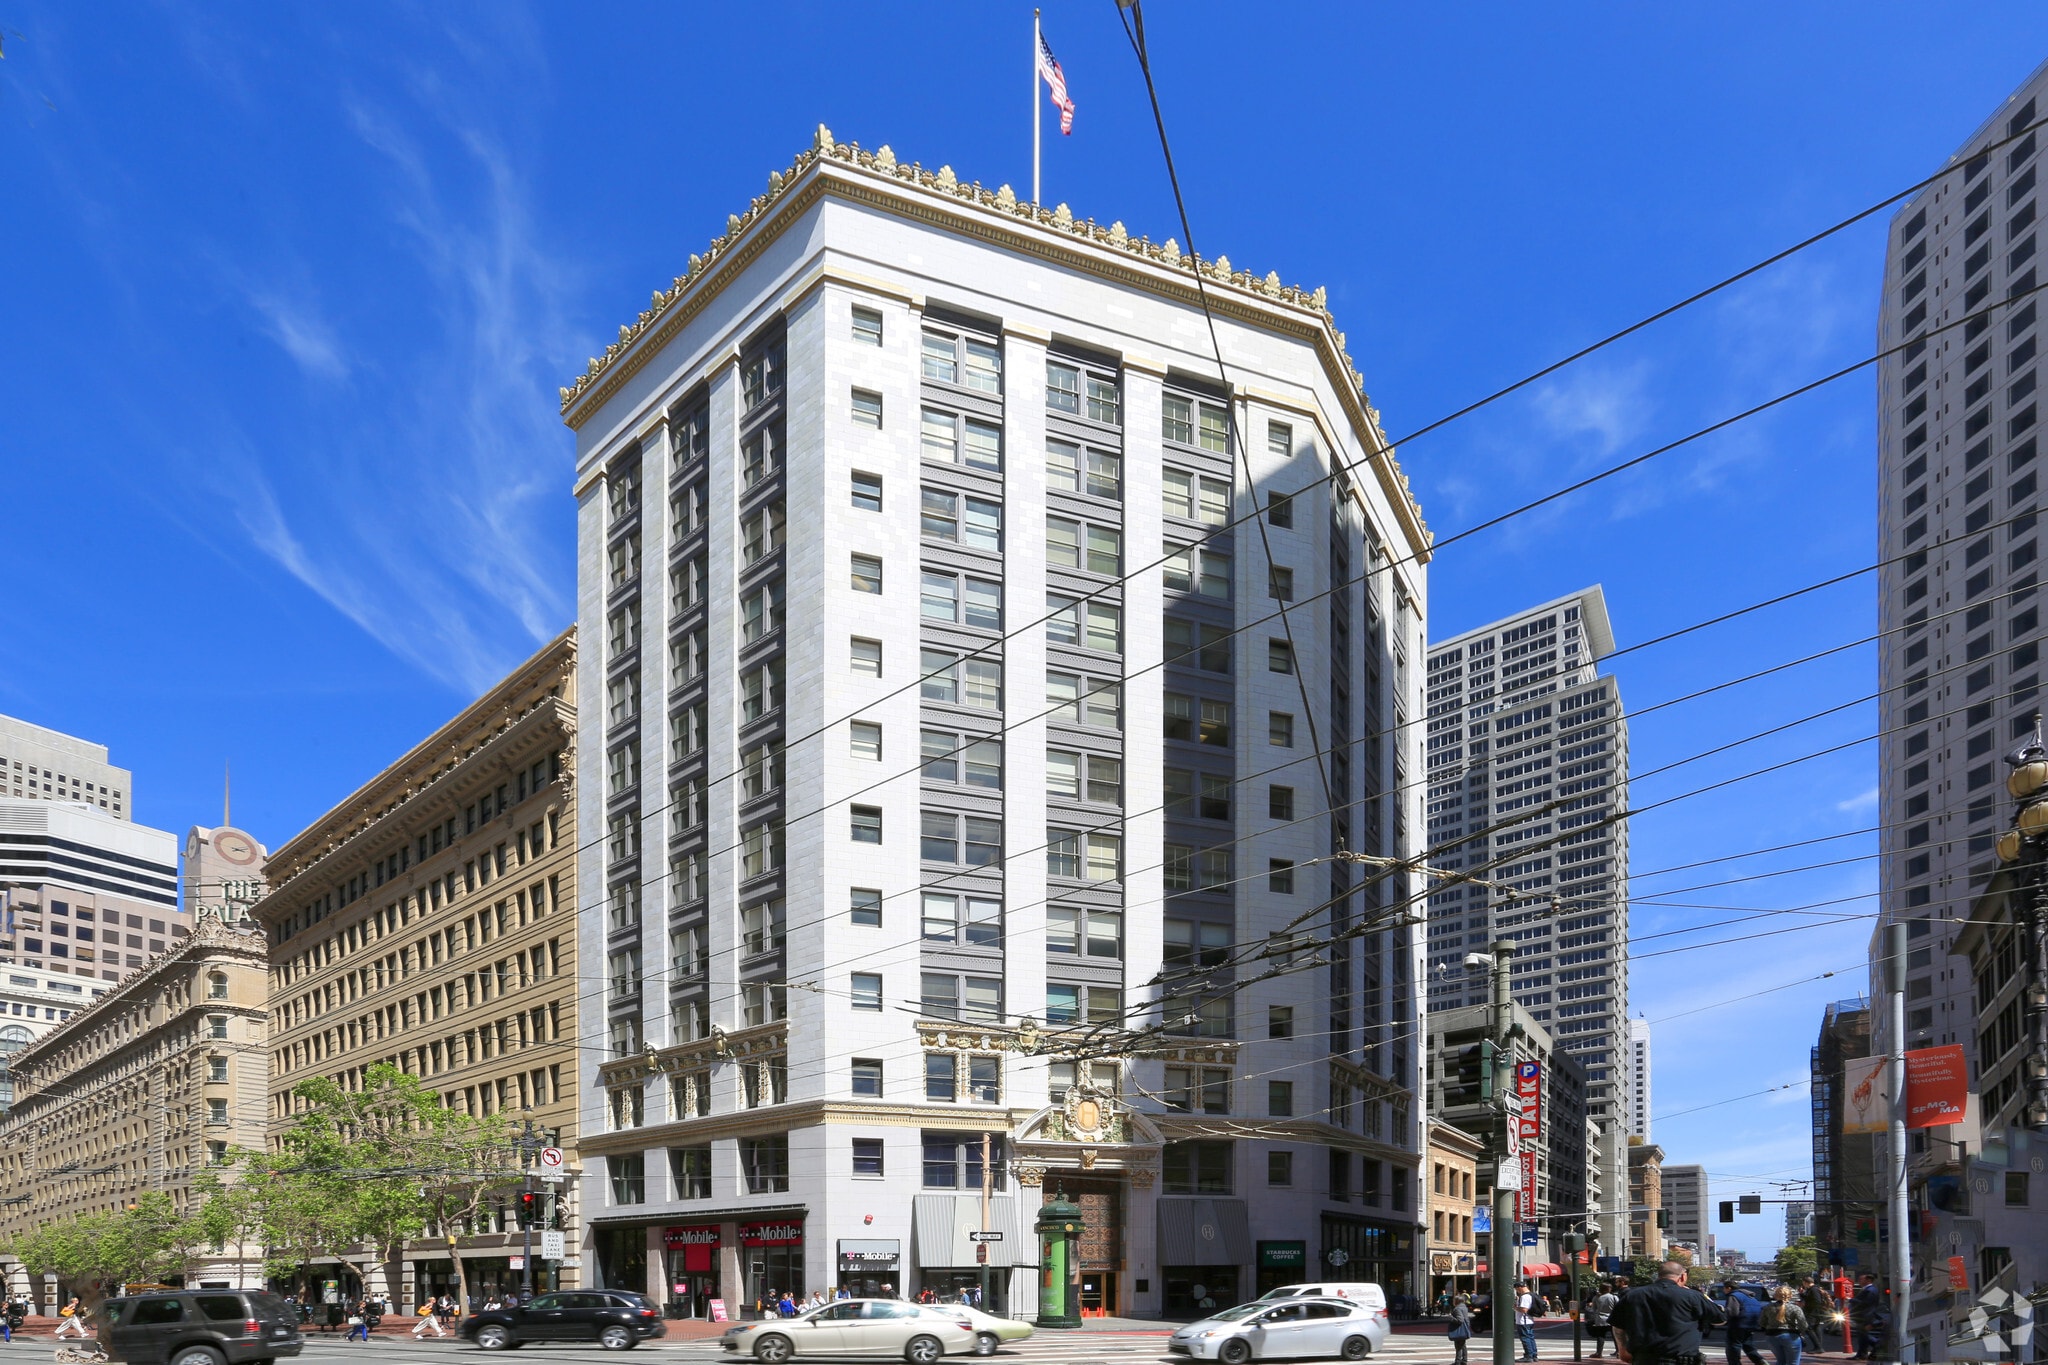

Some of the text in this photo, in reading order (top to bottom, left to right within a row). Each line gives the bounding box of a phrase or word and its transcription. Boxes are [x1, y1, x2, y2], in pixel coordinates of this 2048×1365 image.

[218, 880, 260, 899] THE
[195, 904, 253, 924] PALA
[1908, 1053, 1957, 1064] Mysteriously
[1523, 1065, 1534, 1077] P
[1521, 1079, 1537, 1135] PARK
